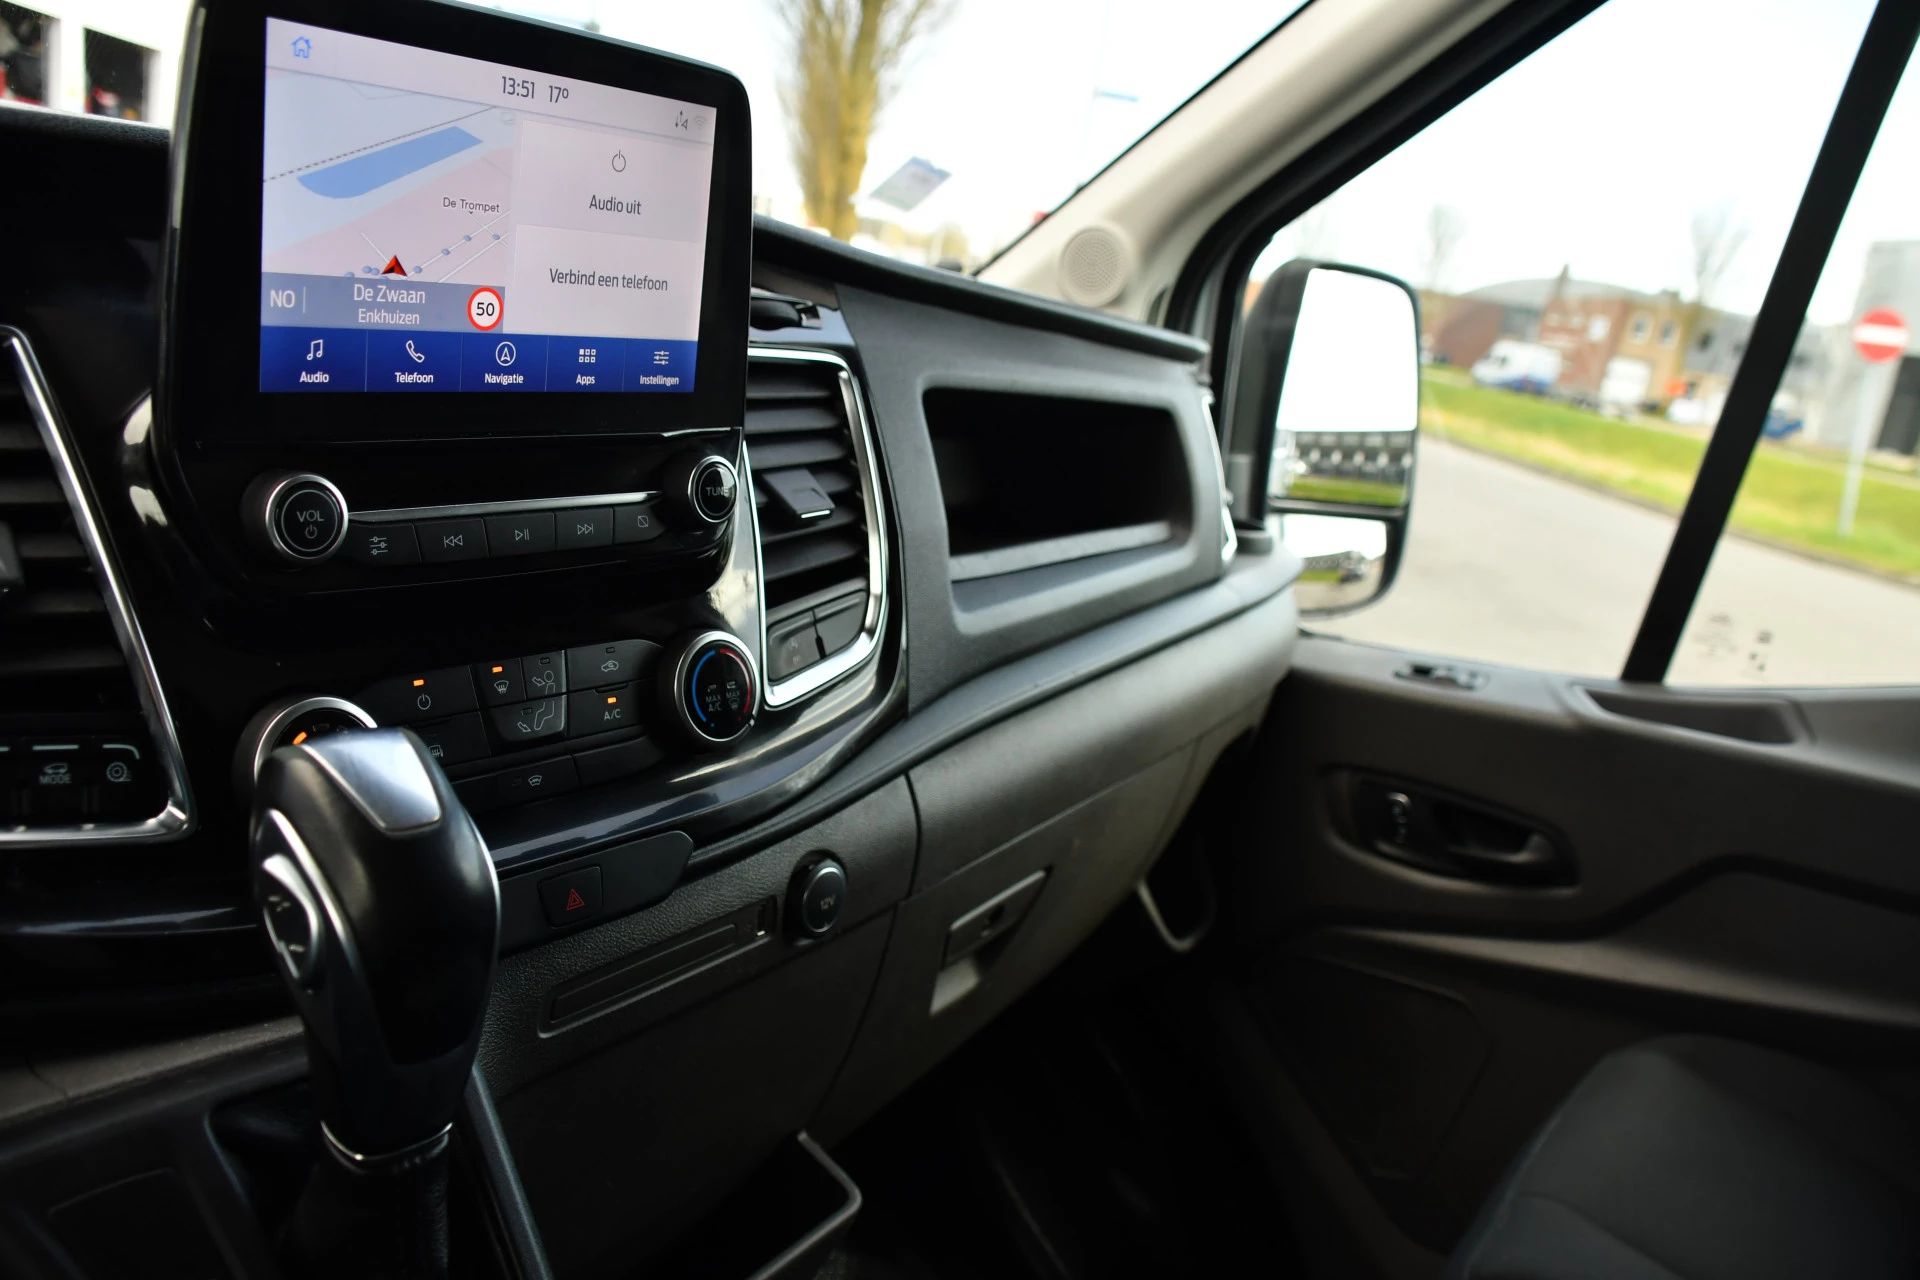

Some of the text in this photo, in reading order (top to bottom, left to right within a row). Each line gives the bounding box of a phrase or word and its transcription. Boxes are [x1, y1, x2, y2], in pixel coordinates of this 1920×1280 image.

[502, 76, 535, 99] 13:51
[443, 197, 500, 213] De Trompet
[589, 194, 642, 215] Audio uit
[549, 267, 669, 291] Verbind een telefoon
[270, 289, 296, 308] NO
[354, 283, 426, 304] De Zwaan
[358, 308, 420, 325] Enkhuizen
[476, 302, 495, 317] 50
[299, 371, 330, 383] Audio
[395, 372, 434, 384] Telefoon
[484, 372, 524, 386] Navigatie
[576, 374, 596, 386] Apps
[639, 375, 680, 387] Instellingen
[705, 486, 730, 498] TUNE
[296, 510, 325, 522] VOL
[603, 708, 622, 721] A/C
[39, 773, 72, 785] MODE
